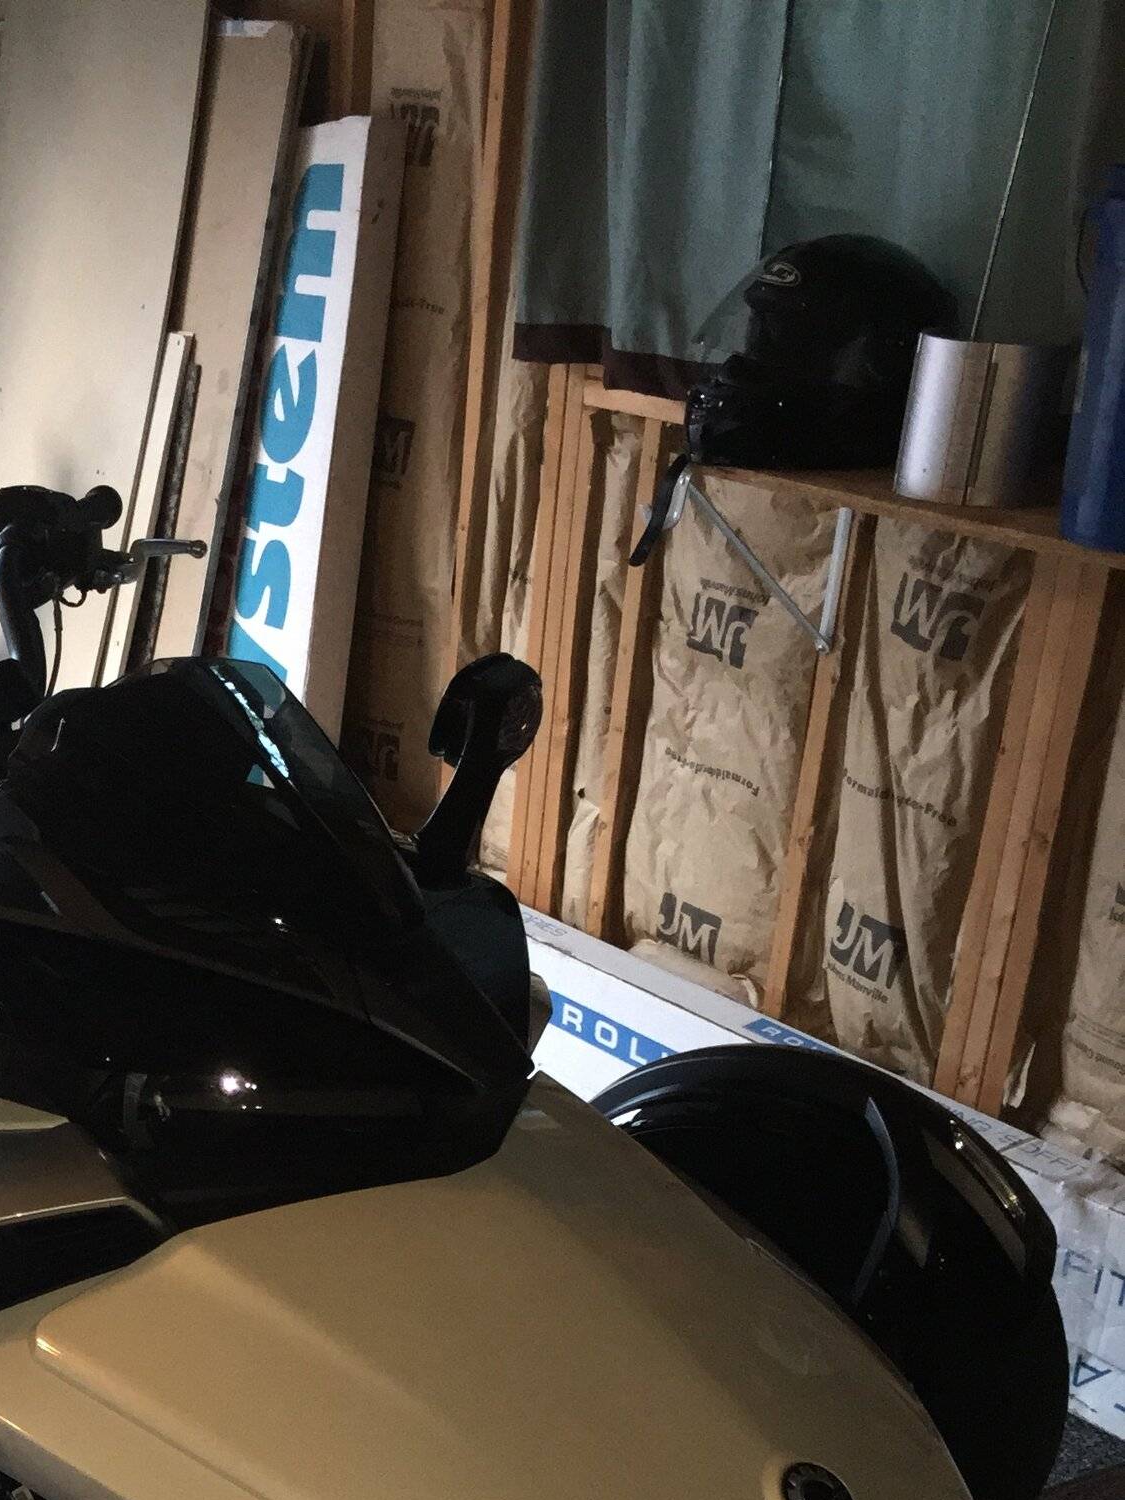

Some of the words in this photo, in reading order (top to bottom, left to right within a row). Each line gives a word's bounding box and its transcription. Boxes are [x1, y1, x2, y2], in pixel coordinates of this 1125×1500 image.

[686, 592, 759, 670] JM
[891, 572, 985, 661] JM
[656, 891, 723, 966] JM
[828, 901, 907, 991] JM
[561, 1002, 671, 1065] ROL
[760, 1025, 822, 1051] RO
